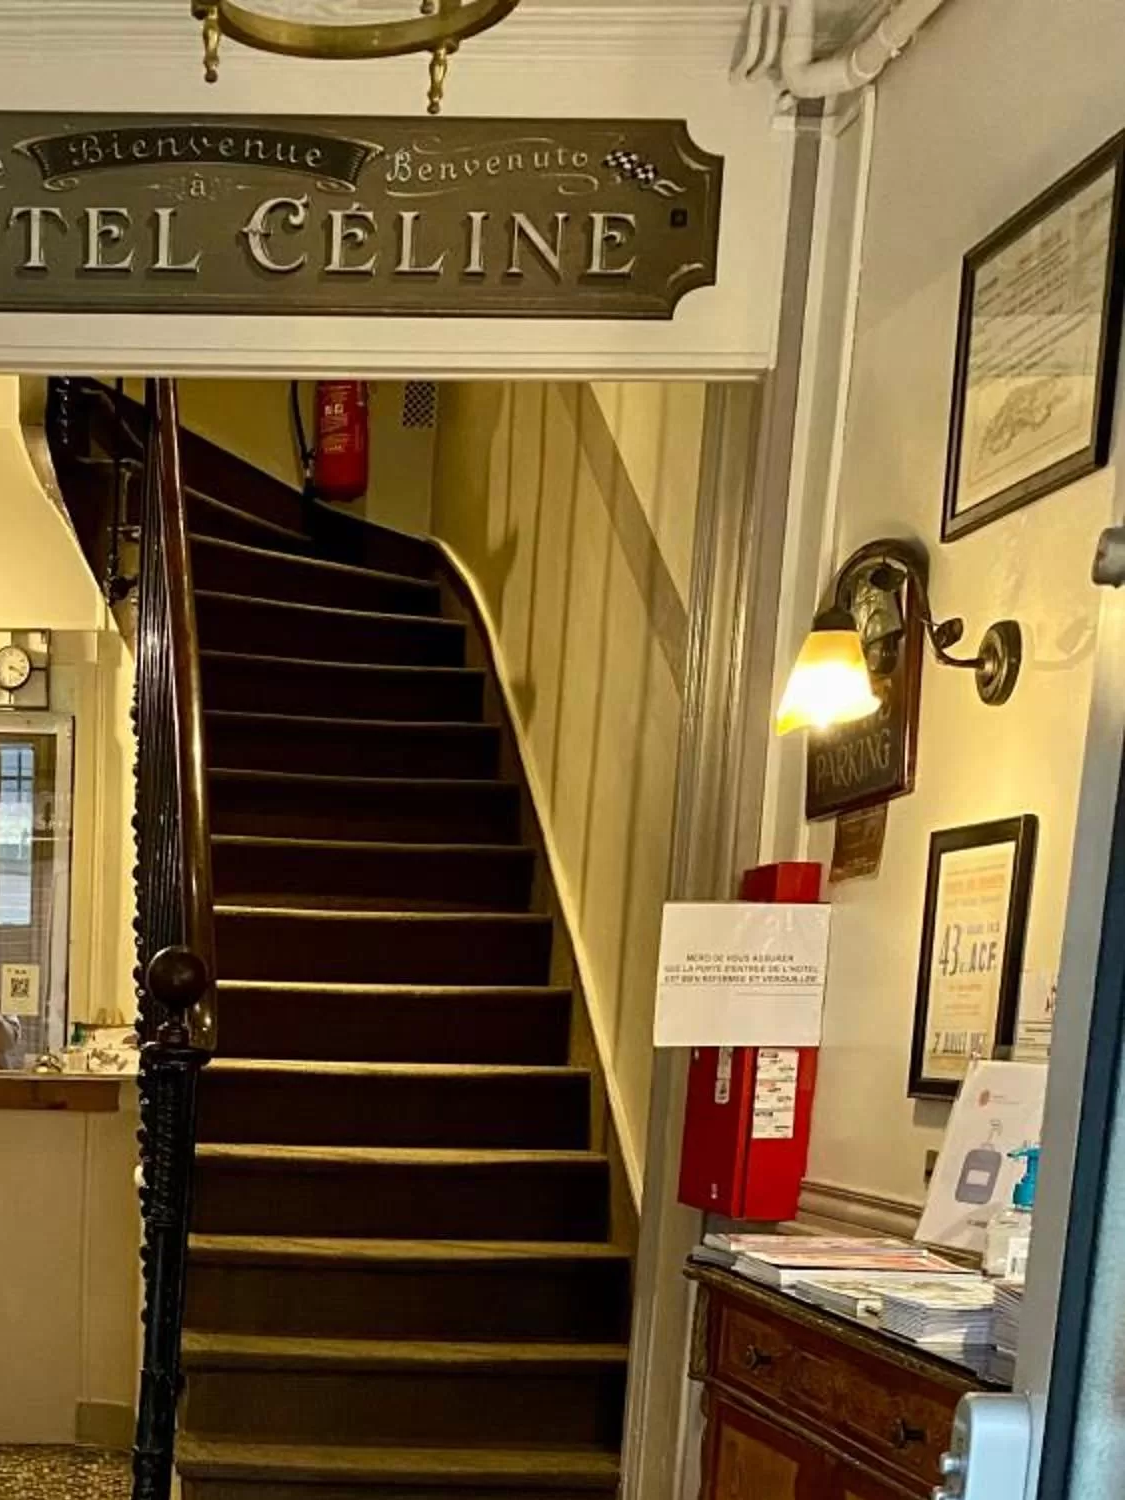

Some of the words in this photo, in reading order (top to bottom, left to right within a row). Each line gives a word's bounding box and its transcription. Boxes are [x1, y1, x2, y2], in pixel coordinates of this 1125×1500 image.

[69, 134, 324, 168] Bienvenue
[386, 147, 588, 182] Benvenuto
[240, 193, 637, 283] CÉLINE
[815, 728, 891, 794] PARKING
